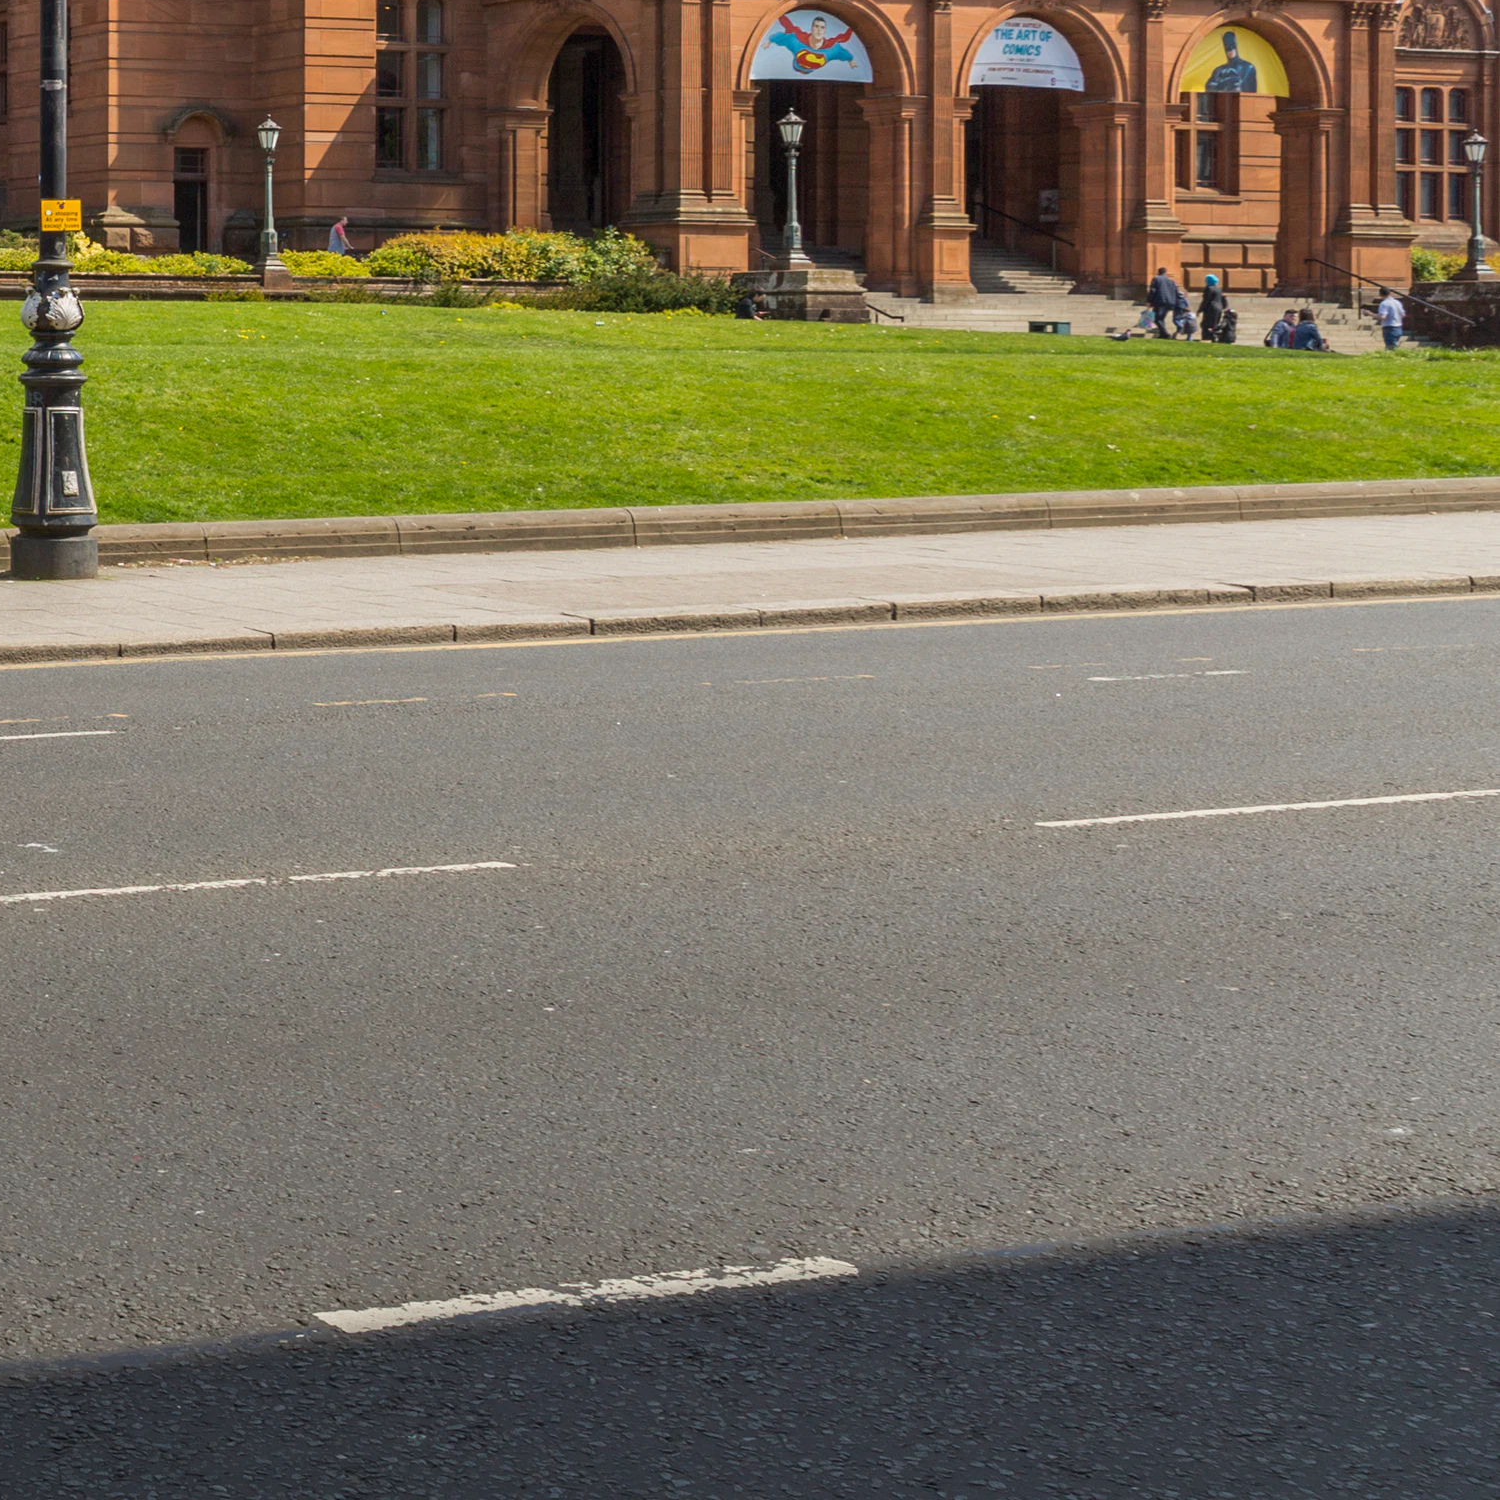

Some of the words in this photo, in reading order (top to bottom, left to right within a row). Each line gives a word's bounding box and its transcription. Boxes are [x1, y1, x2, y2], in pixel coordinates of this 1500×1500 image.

[994, 28, 1014, 40] THE
[1016, 29, 1037, 41] ART
[1039, 31, 1052, 42] OF
[1002, 43, 1042, 56] COMICS
